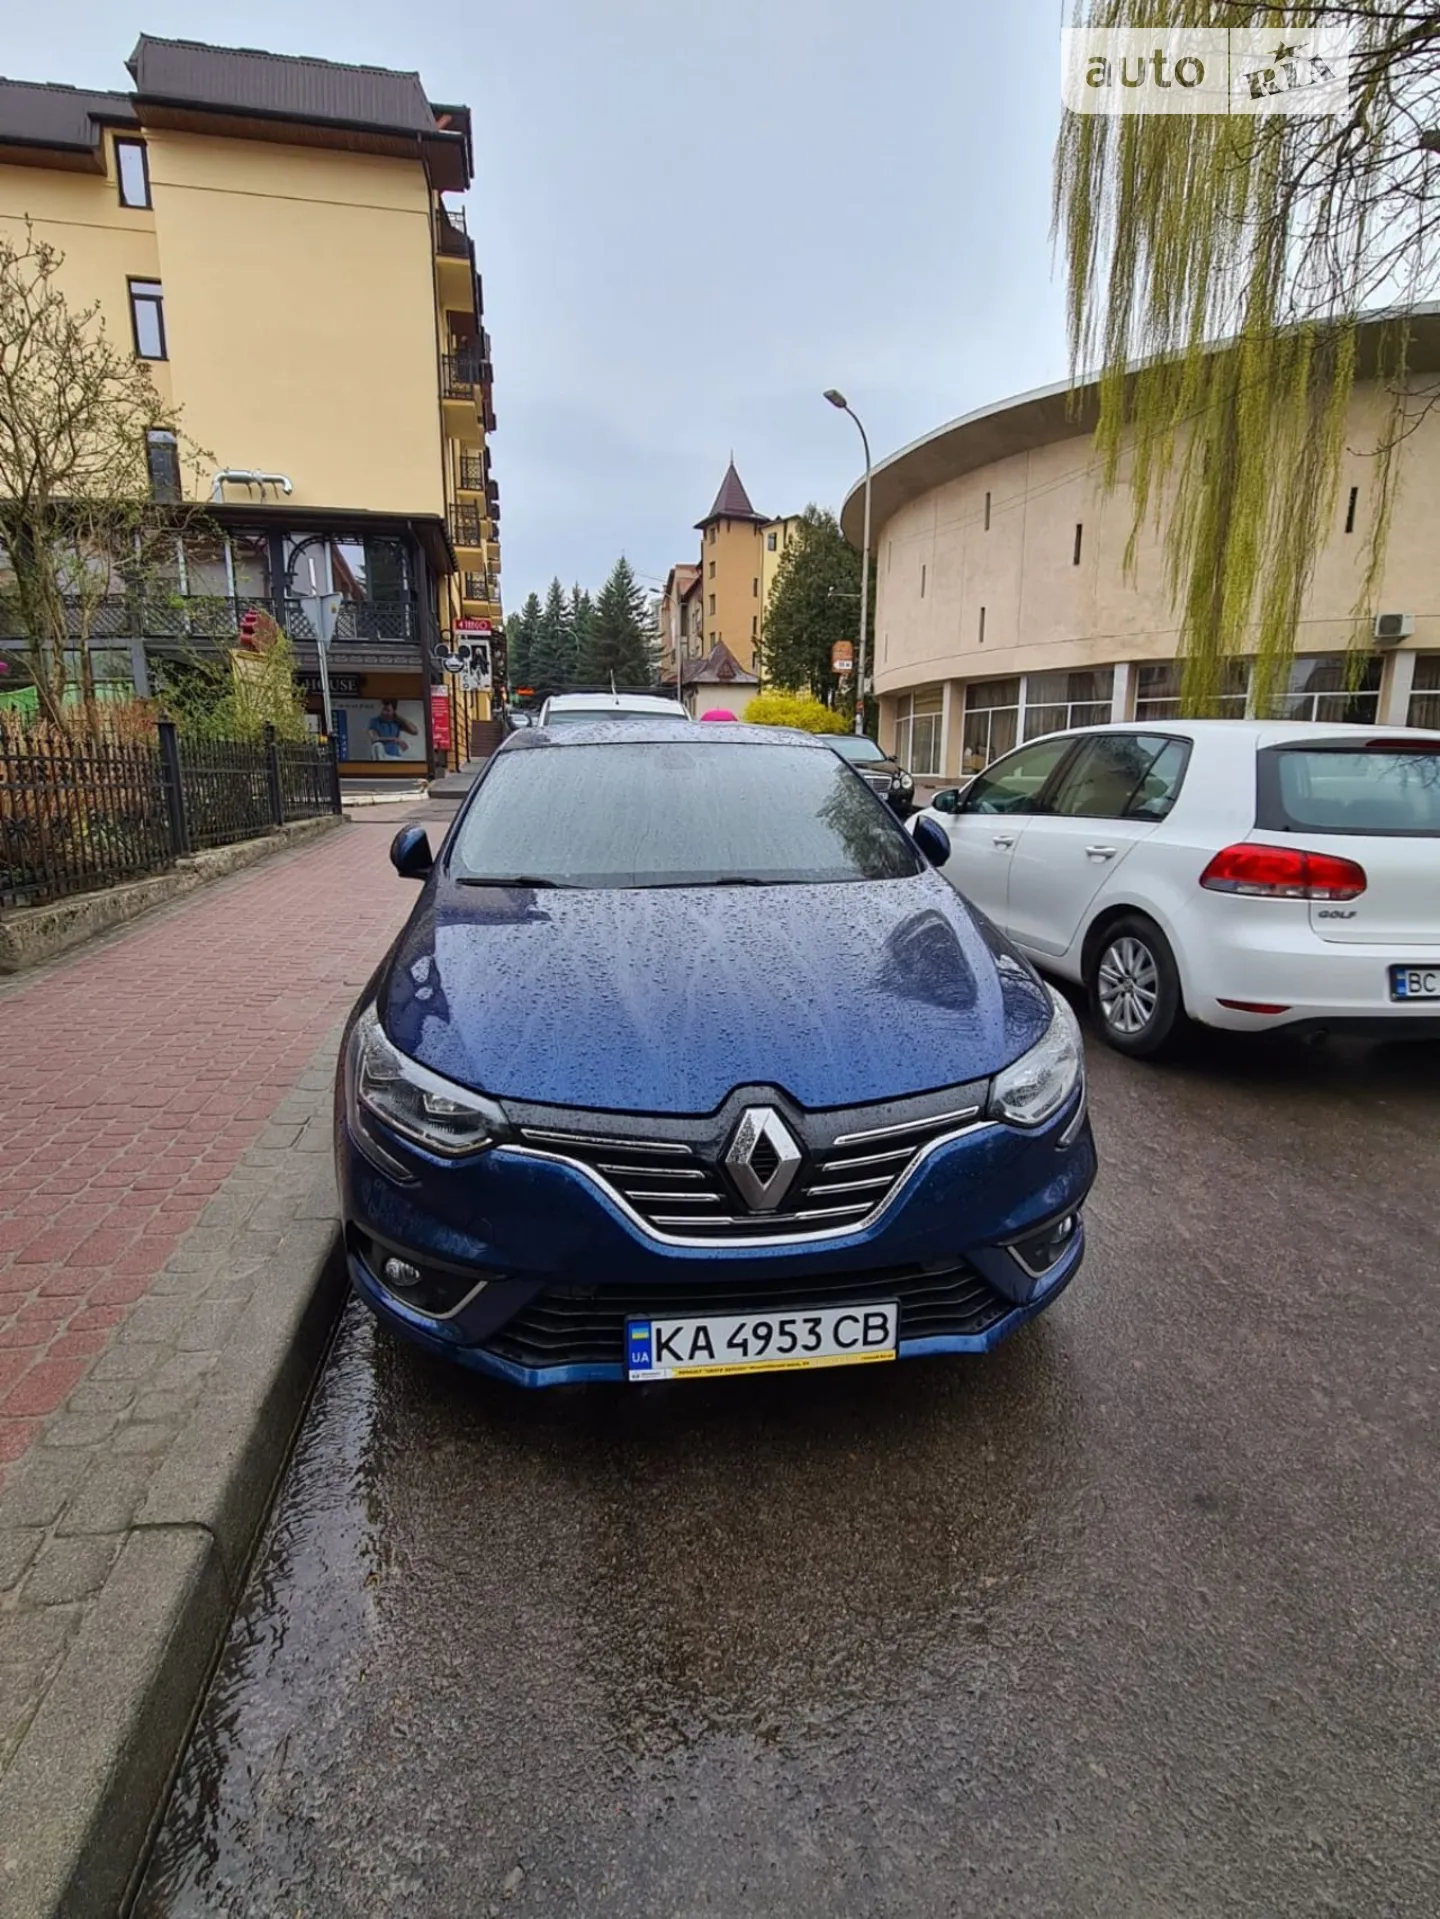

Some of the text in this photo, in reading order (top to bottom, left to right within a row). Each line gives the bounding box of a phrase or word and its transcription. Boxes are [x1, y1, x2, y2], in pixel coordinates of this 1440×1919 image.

[1318, 910, 1357, 919] GOLF
[1408, 972, 1437, 994] BC
[655, 1311, 890, 1363] KA 4953 CB
[631, 1352, 650, 1363] UA
